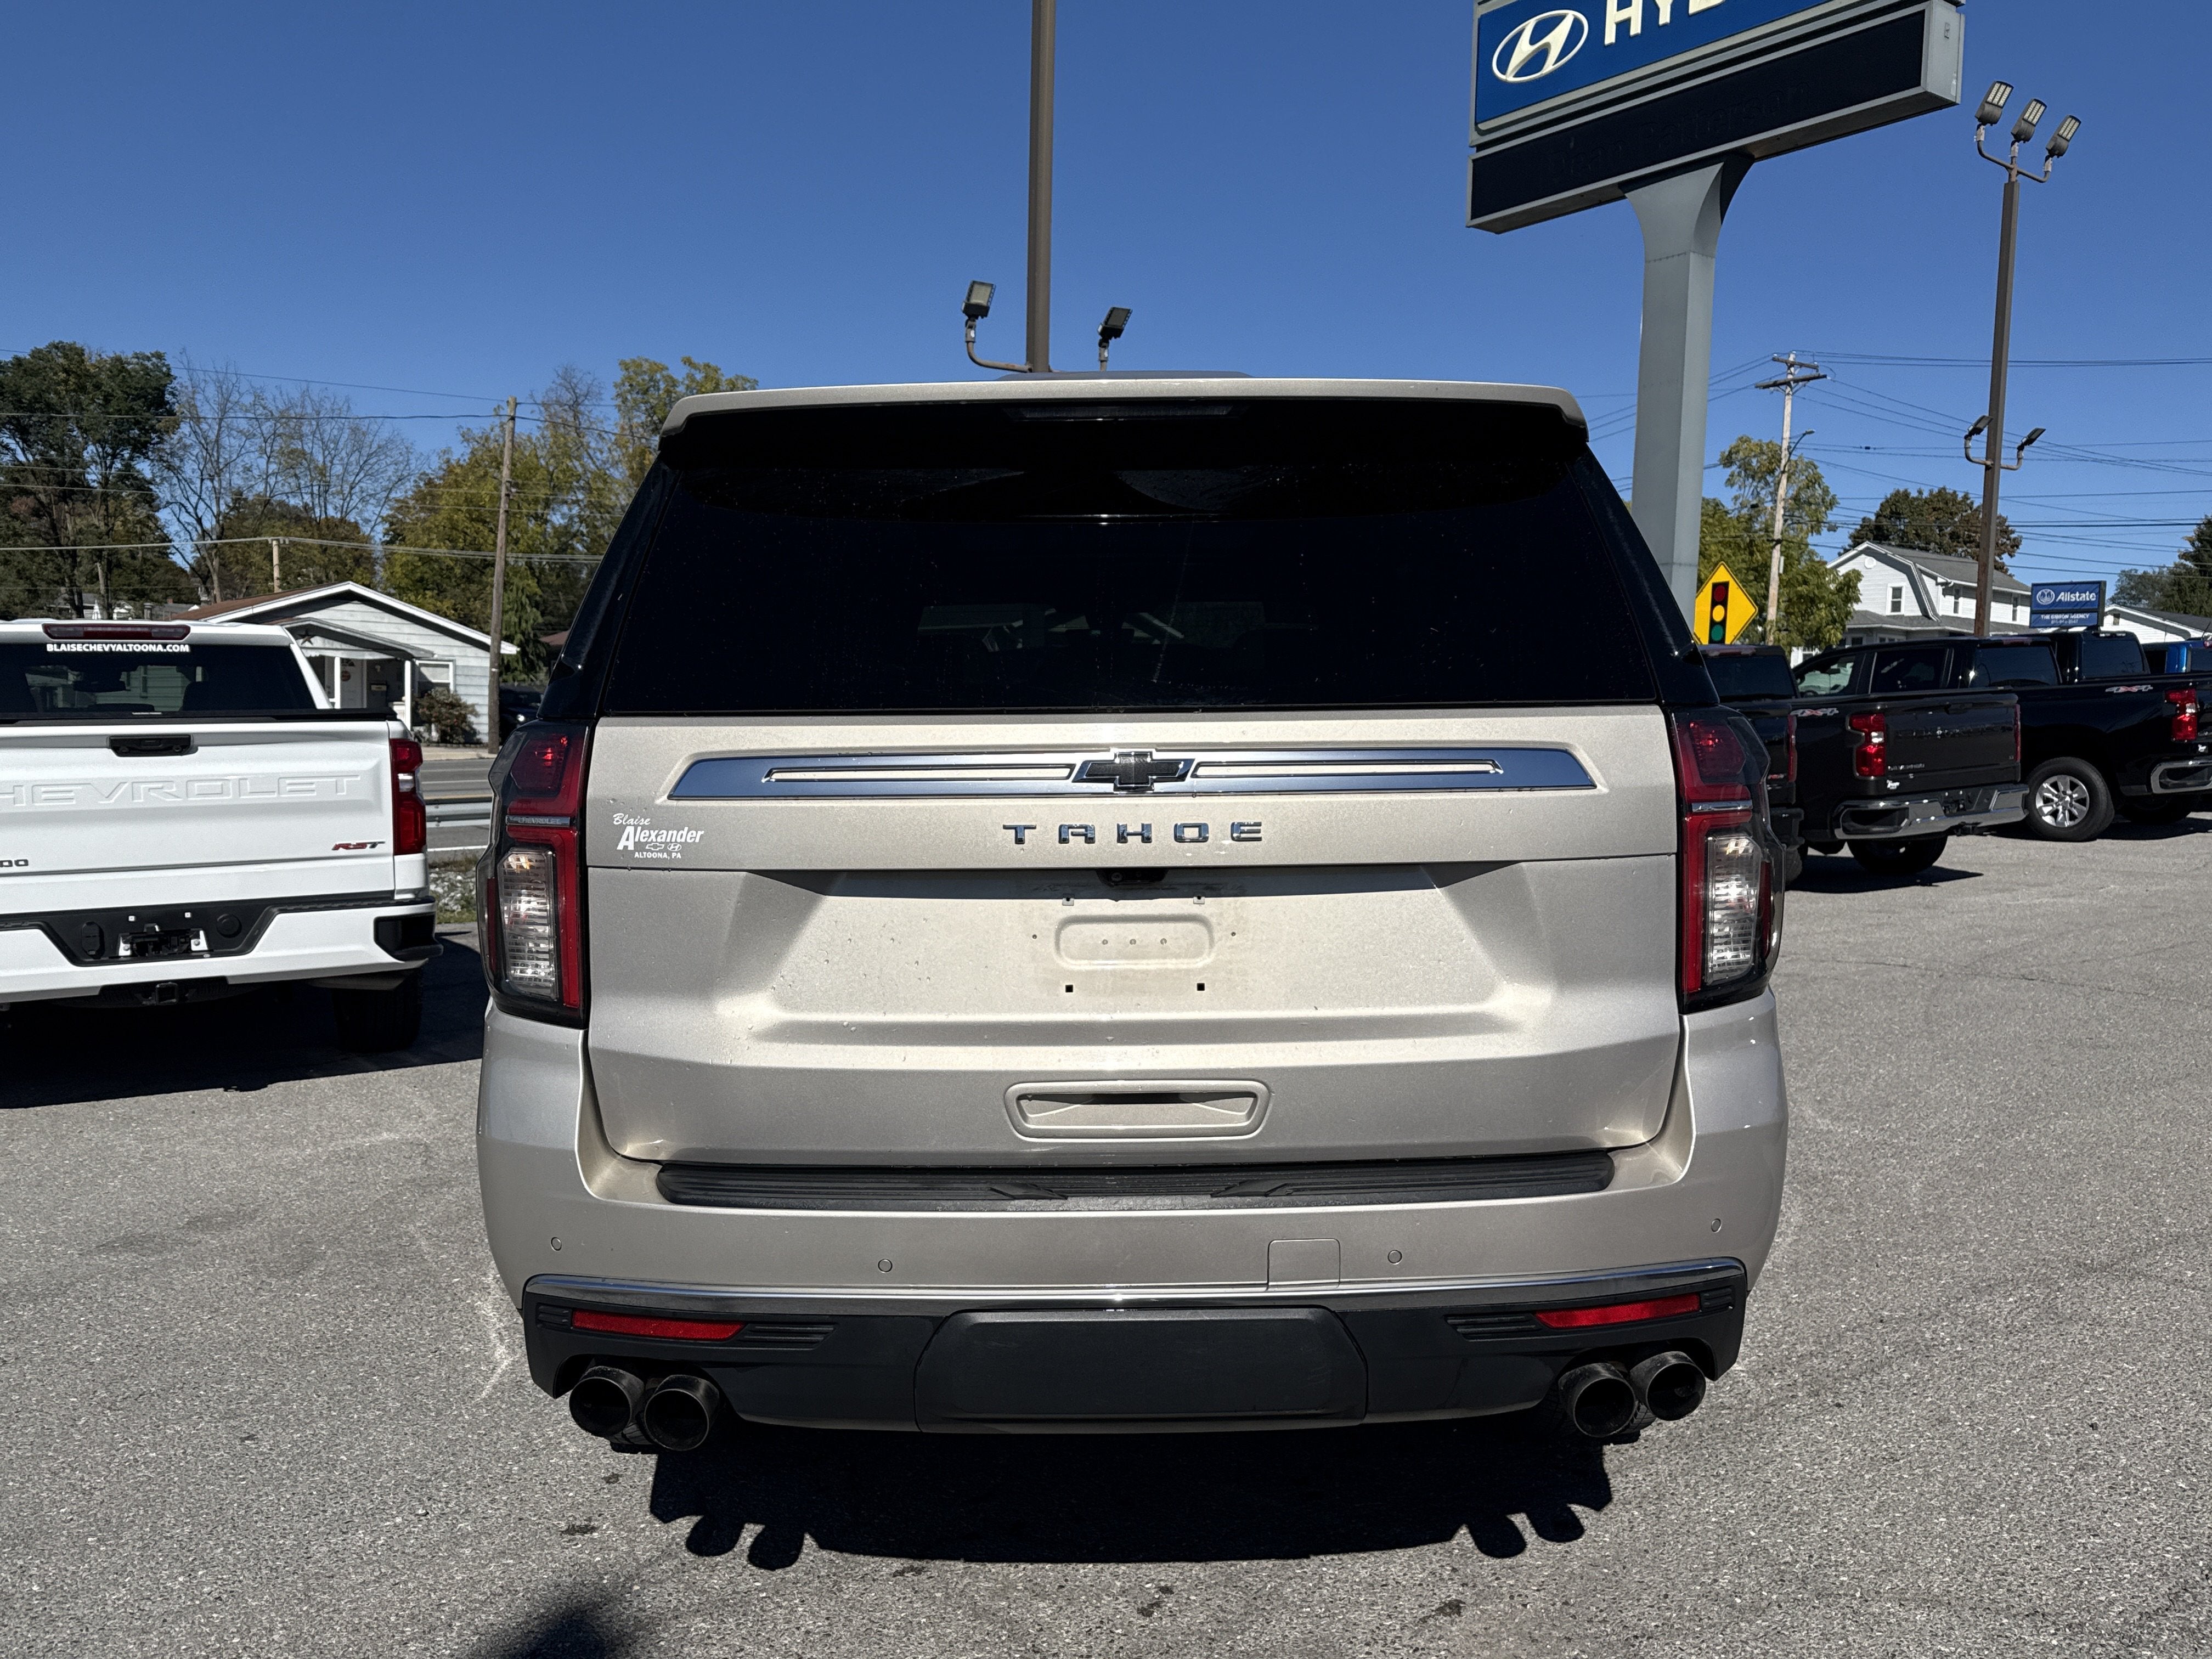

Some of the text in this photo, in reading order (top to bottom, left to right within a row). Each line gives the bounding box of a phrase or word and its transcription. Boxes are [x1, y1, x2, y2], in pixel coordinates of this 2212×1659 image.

[2056, 591, 2096, 602] Allstate
[46, 644, 189, 652] BLAISECHEVYALTOONA.COM
[613, 812, 651, 825] Blaise
[616, 825, 704, 850] Alexander
[1002, 821, 1263, 844] TAHOE
[331, 841, 386, 851] RST
